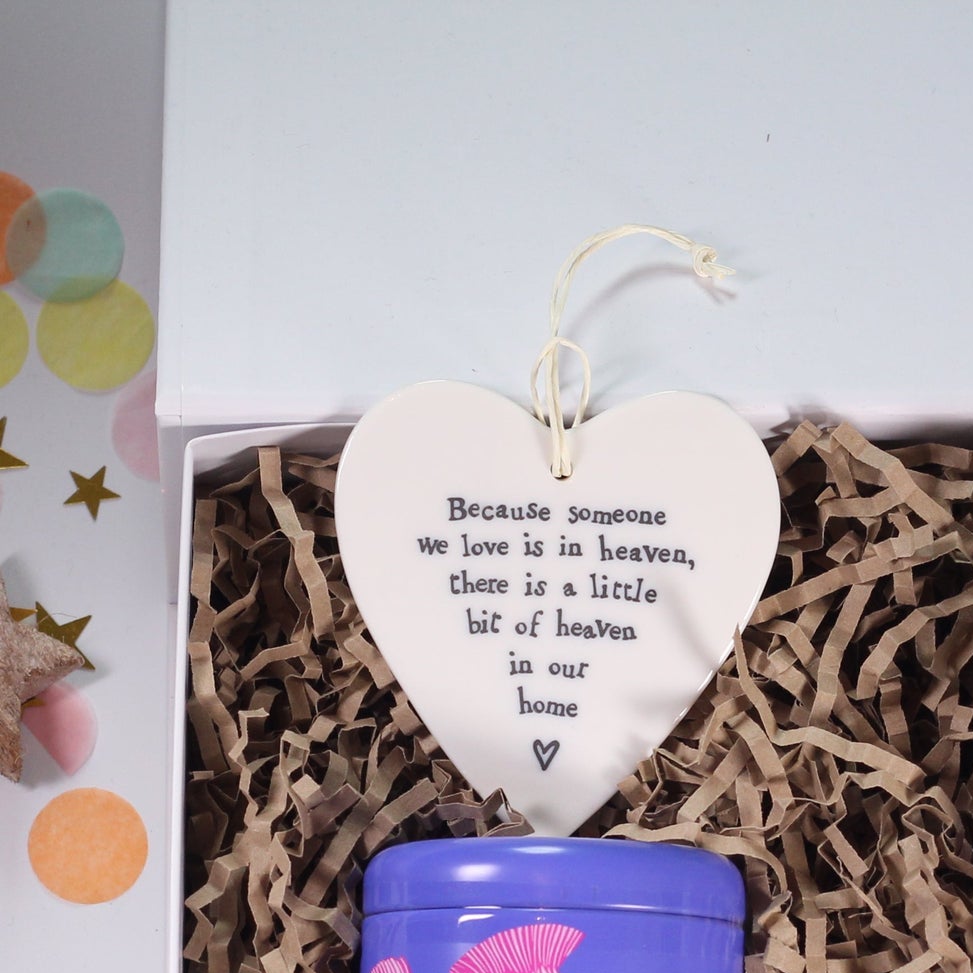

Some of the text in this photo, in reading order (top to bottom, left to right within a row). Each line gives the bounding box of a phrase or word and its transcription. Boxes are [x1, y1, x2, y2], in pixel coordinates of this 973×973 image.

[447, 497, 667, 525] Because someone
[417, 532, 695, 570] we love is in heaven,
[450, 570, 657, 603] there is a little
[466, 608, 637, 640] bit of heaven
[509, 651, 589, 678] in our
[517, 686, 578, 717] home
